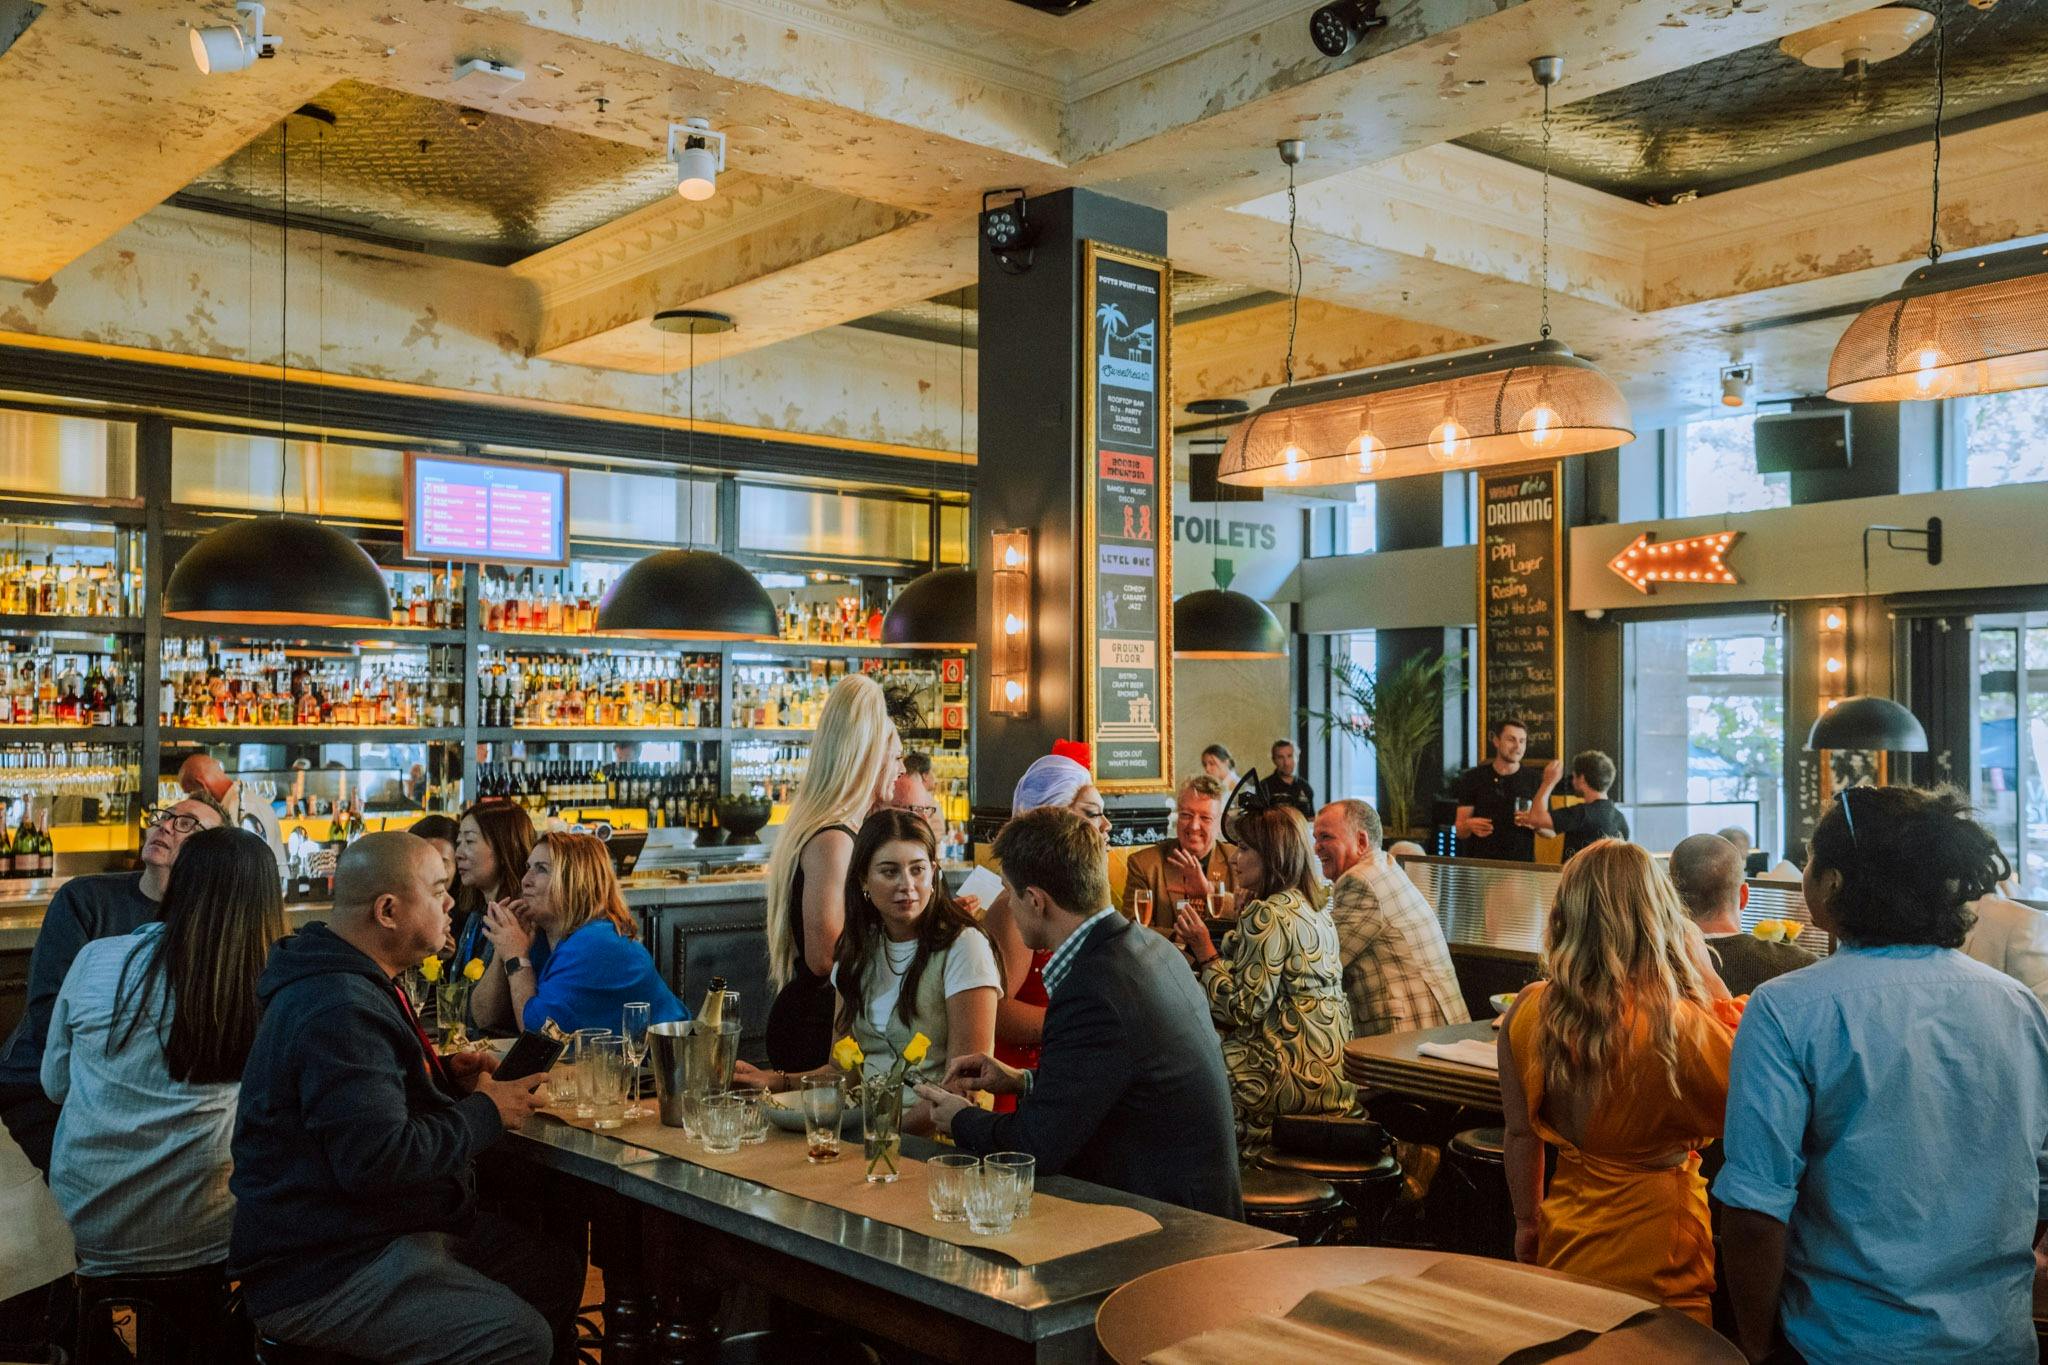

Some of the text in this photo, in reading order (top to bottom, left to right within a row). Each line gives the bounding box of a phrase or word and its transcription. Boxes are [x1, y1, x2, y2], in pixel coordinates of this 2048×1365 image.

[1099, 275, 1156, 294] POTTS POINT HOTEL
[1108, 395, 1144, 407] ROOFTOP BAR
[1125, 407, 1142, 416] PARTY
[1115, 415, 1138, 424] SUNSETS
[1112, 424, 1141, 434] COCKTAILS
[1130, 487, 1147, 496] MUSIC
[1489, 486, 1519, 499] WHAT
[1119, 495, 1135, 503] DISCO
[1487, 498, 1552, 526] DRINKING
[1174, 515, 1275, 550] TOILETS
[1492, 544, 1516, 561] PPH
[1102, 553, 1150, 566] LEVEL ONE
[1510, 556, 1543, 575] Lager
[1123, 584, 1146, 593] COMEDY
[1122, 593, 1147, 602] CABARET
[1128, 602, 1141, 610] JAZZ
[1112, 643, 1145, 653] GROUND
[1115, 653, 1141, 663] FLOOR
[1118, 672, 1138, 680] BISTRO
[1112, 681, 1144, 689] CRAFT BEER
[1112, 750, 1143, 758] CHECK OUT
